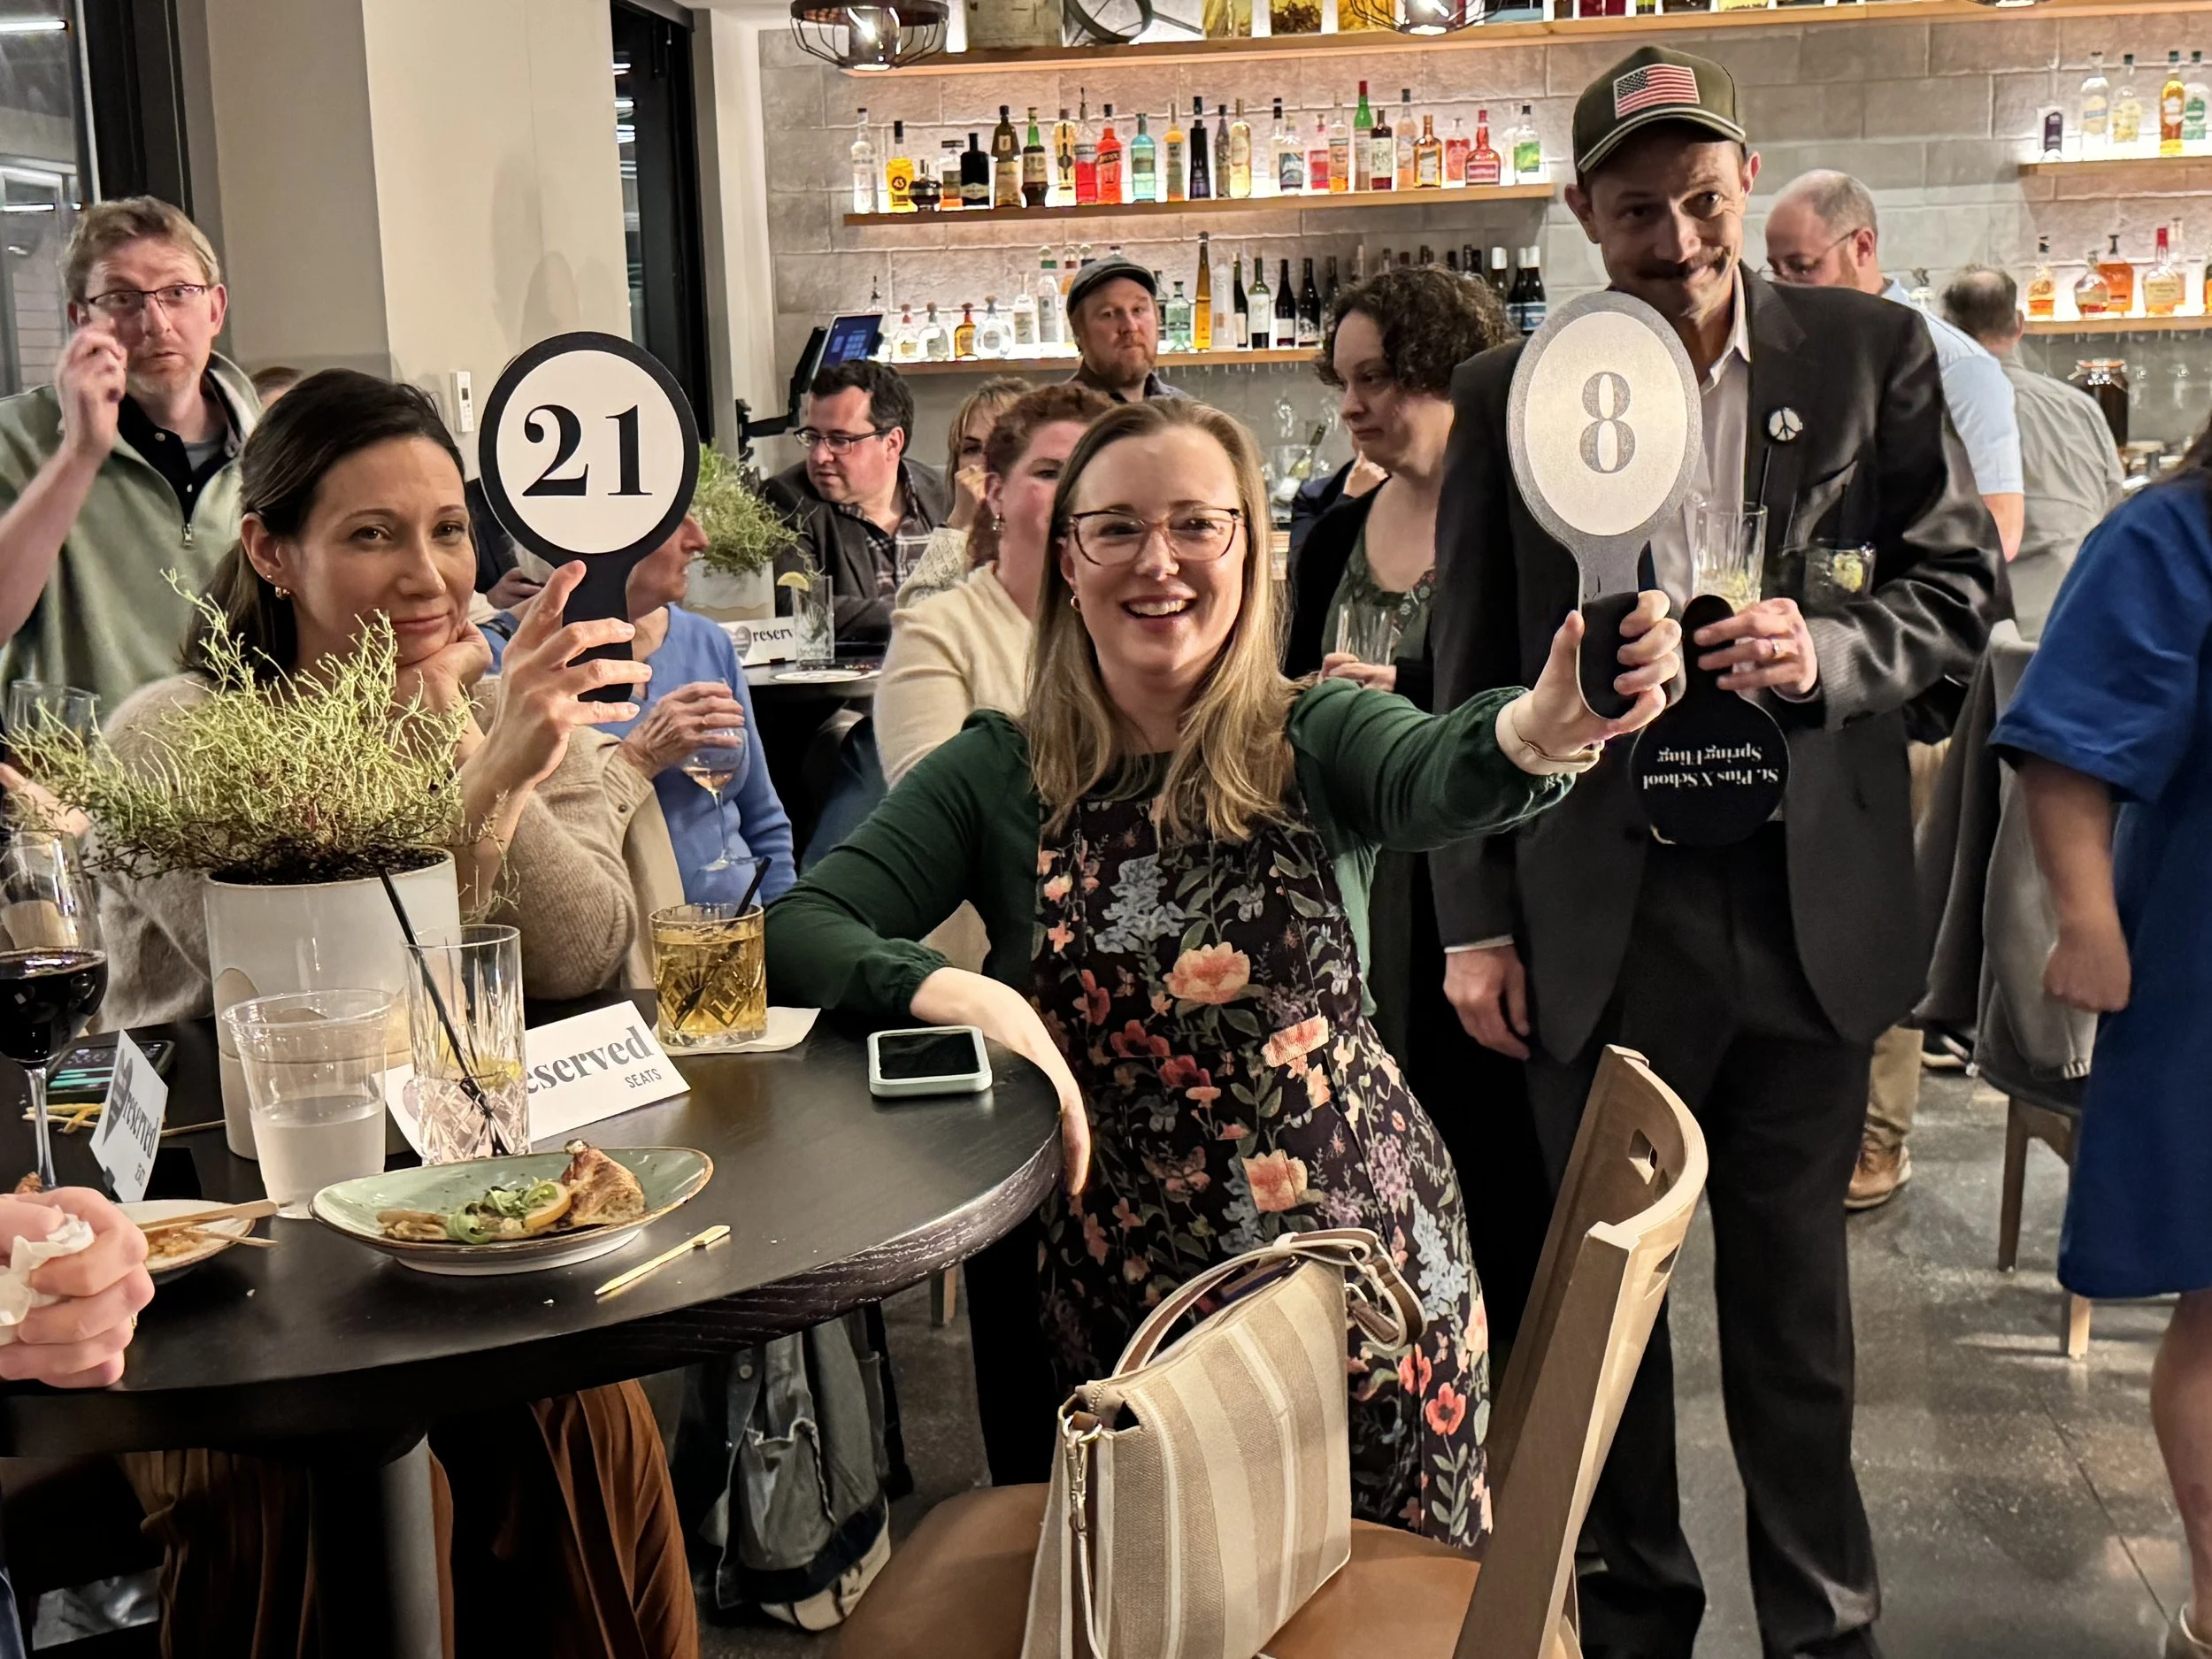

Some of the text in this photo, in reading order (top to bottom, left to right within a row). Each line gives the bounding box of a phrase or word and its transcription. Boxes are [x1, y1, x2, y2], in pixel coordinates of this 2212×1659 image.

[1579, 372, 1635, 473] 8
[522, 404, 654, 496] 21
[752, 628, 793, 642] reserv
[1656, 742, 1763, 765] Spring Fling
[1643, 768, 1779, 789] St. Pius X School
[527, 1025, 655, 1094] eserved
[624, 1068, 662, 1088] SEATS
[123, 1091, 159, 1159] reserved
